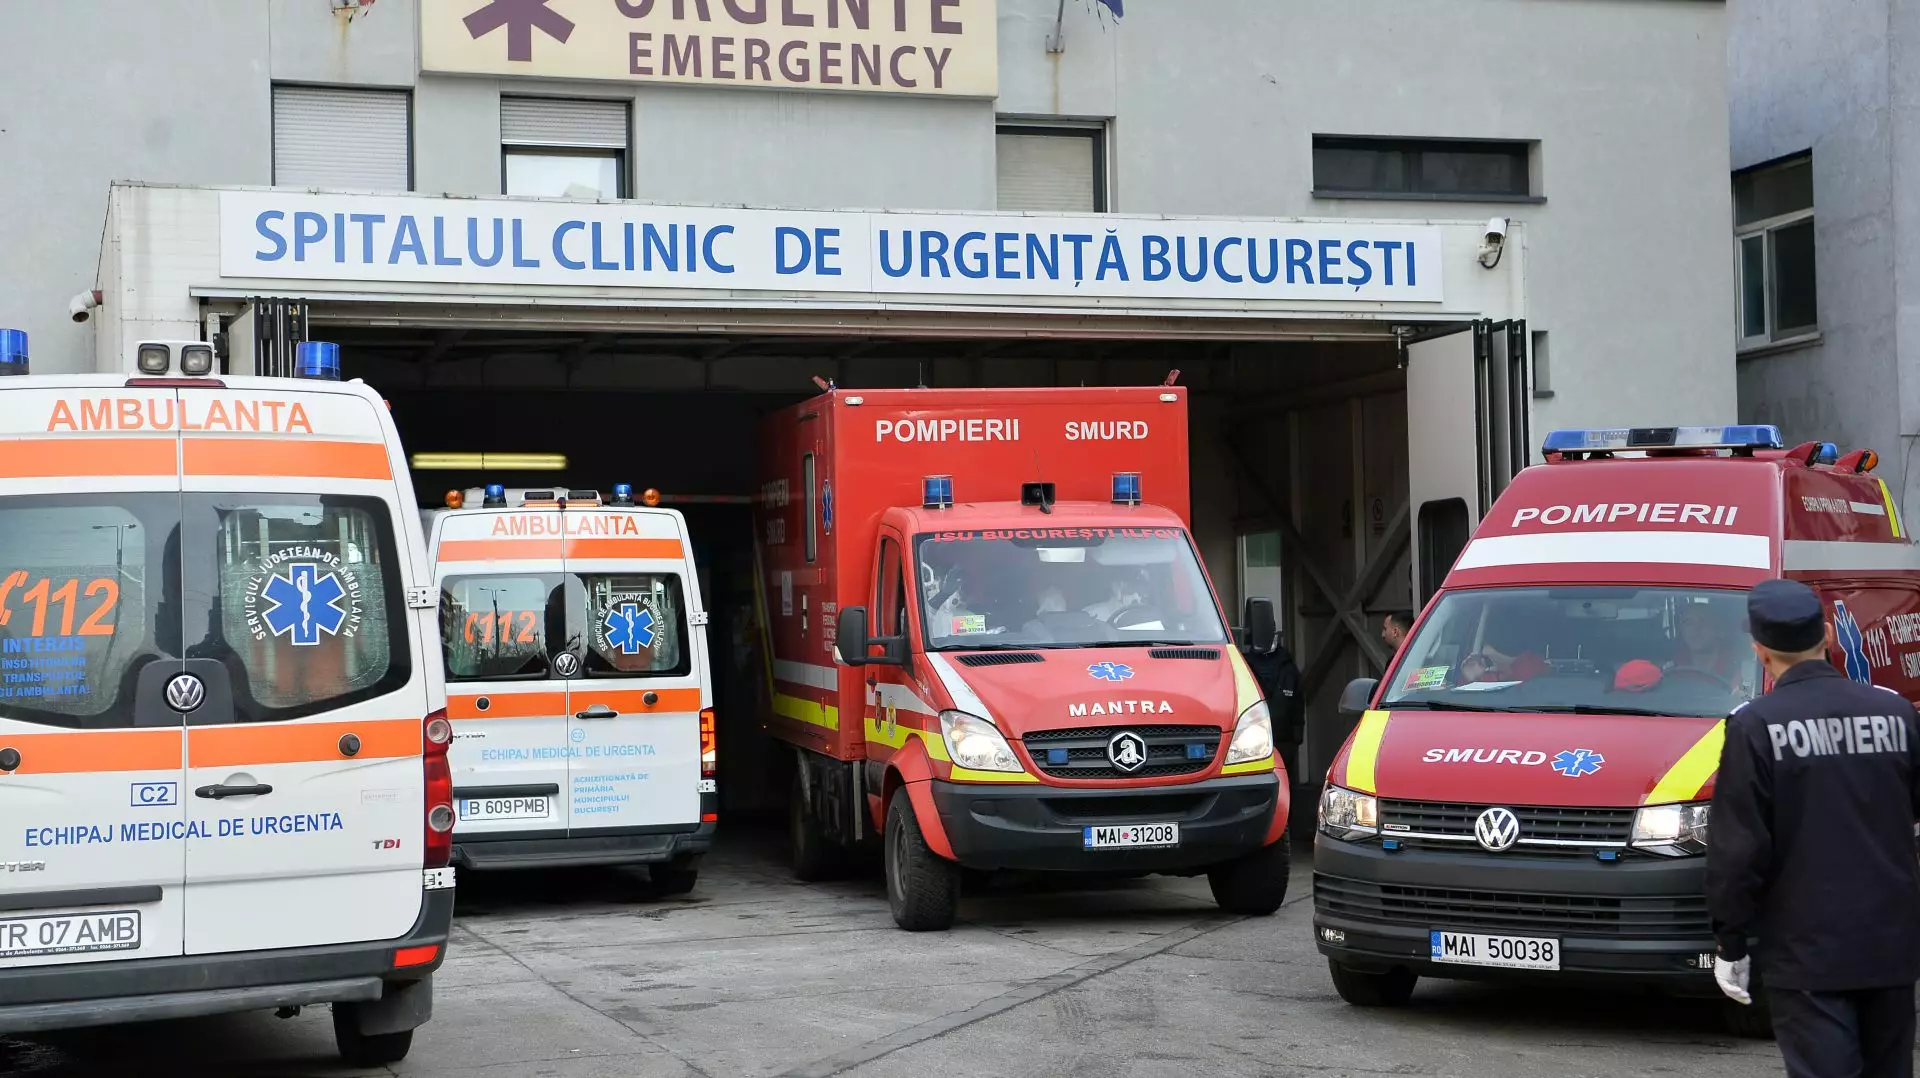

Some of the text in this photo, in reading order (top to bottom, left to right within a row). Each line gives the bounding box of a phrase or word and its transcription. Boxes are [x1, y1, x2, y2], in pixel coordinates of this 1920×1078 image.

[629, 31, 952, 89] EMERGENCY
[255, 209, 540, 268] SPITALUL
[552, 220, 735, 274] CLINIC
[775, 227, 842, 276] DE
[1142, 234, 1416, 292] BUCUREȘTI
[47, 398, 313, 434] AMBULANTA
[876, 418, 1019, 442] POMPIERII
[1065, 421, 1149, 440] SMURD
[491, 515, 639, 536] AMBULANTA
[1512, 503, 1738, 529] POMPIERII
[933, 531, 975, 543] ISU
[23, 577, 119, 637] 112
[245, 576, 267, 640] SERVICIUL
[322, 552, 341, 568] DE
[479, 611, 536, 643] 112
[3, 637, 86, 653] INTERZIS
[1068, 700, 1174, 717] MANTRA
[1767, 715, 1908, 762] POMPIERII
[482, 744, 656, 761] ECHIPAJ MEDICAL DE URGENTA
[1422, 748, 1547, 766] SMURD
[140, 786, 169, 803] C2
[470, 801, 480, 815] B
[485, 800, 512, 814] 609
[514, 798, 545, 813] PMB
[25, 812, 343, 847] ECHIPAJ MEDICAL DE URGENTA
[1097, 828, 1120, 844] MAI
[1130, 826, 1174, 843] 31208
[372, 838, 401, 850] TDI
[39, 920, 71, 945] 07
[75, 917, 135, 944] AMB
[1432, 935, 1554, 962] RO MAI 50038
